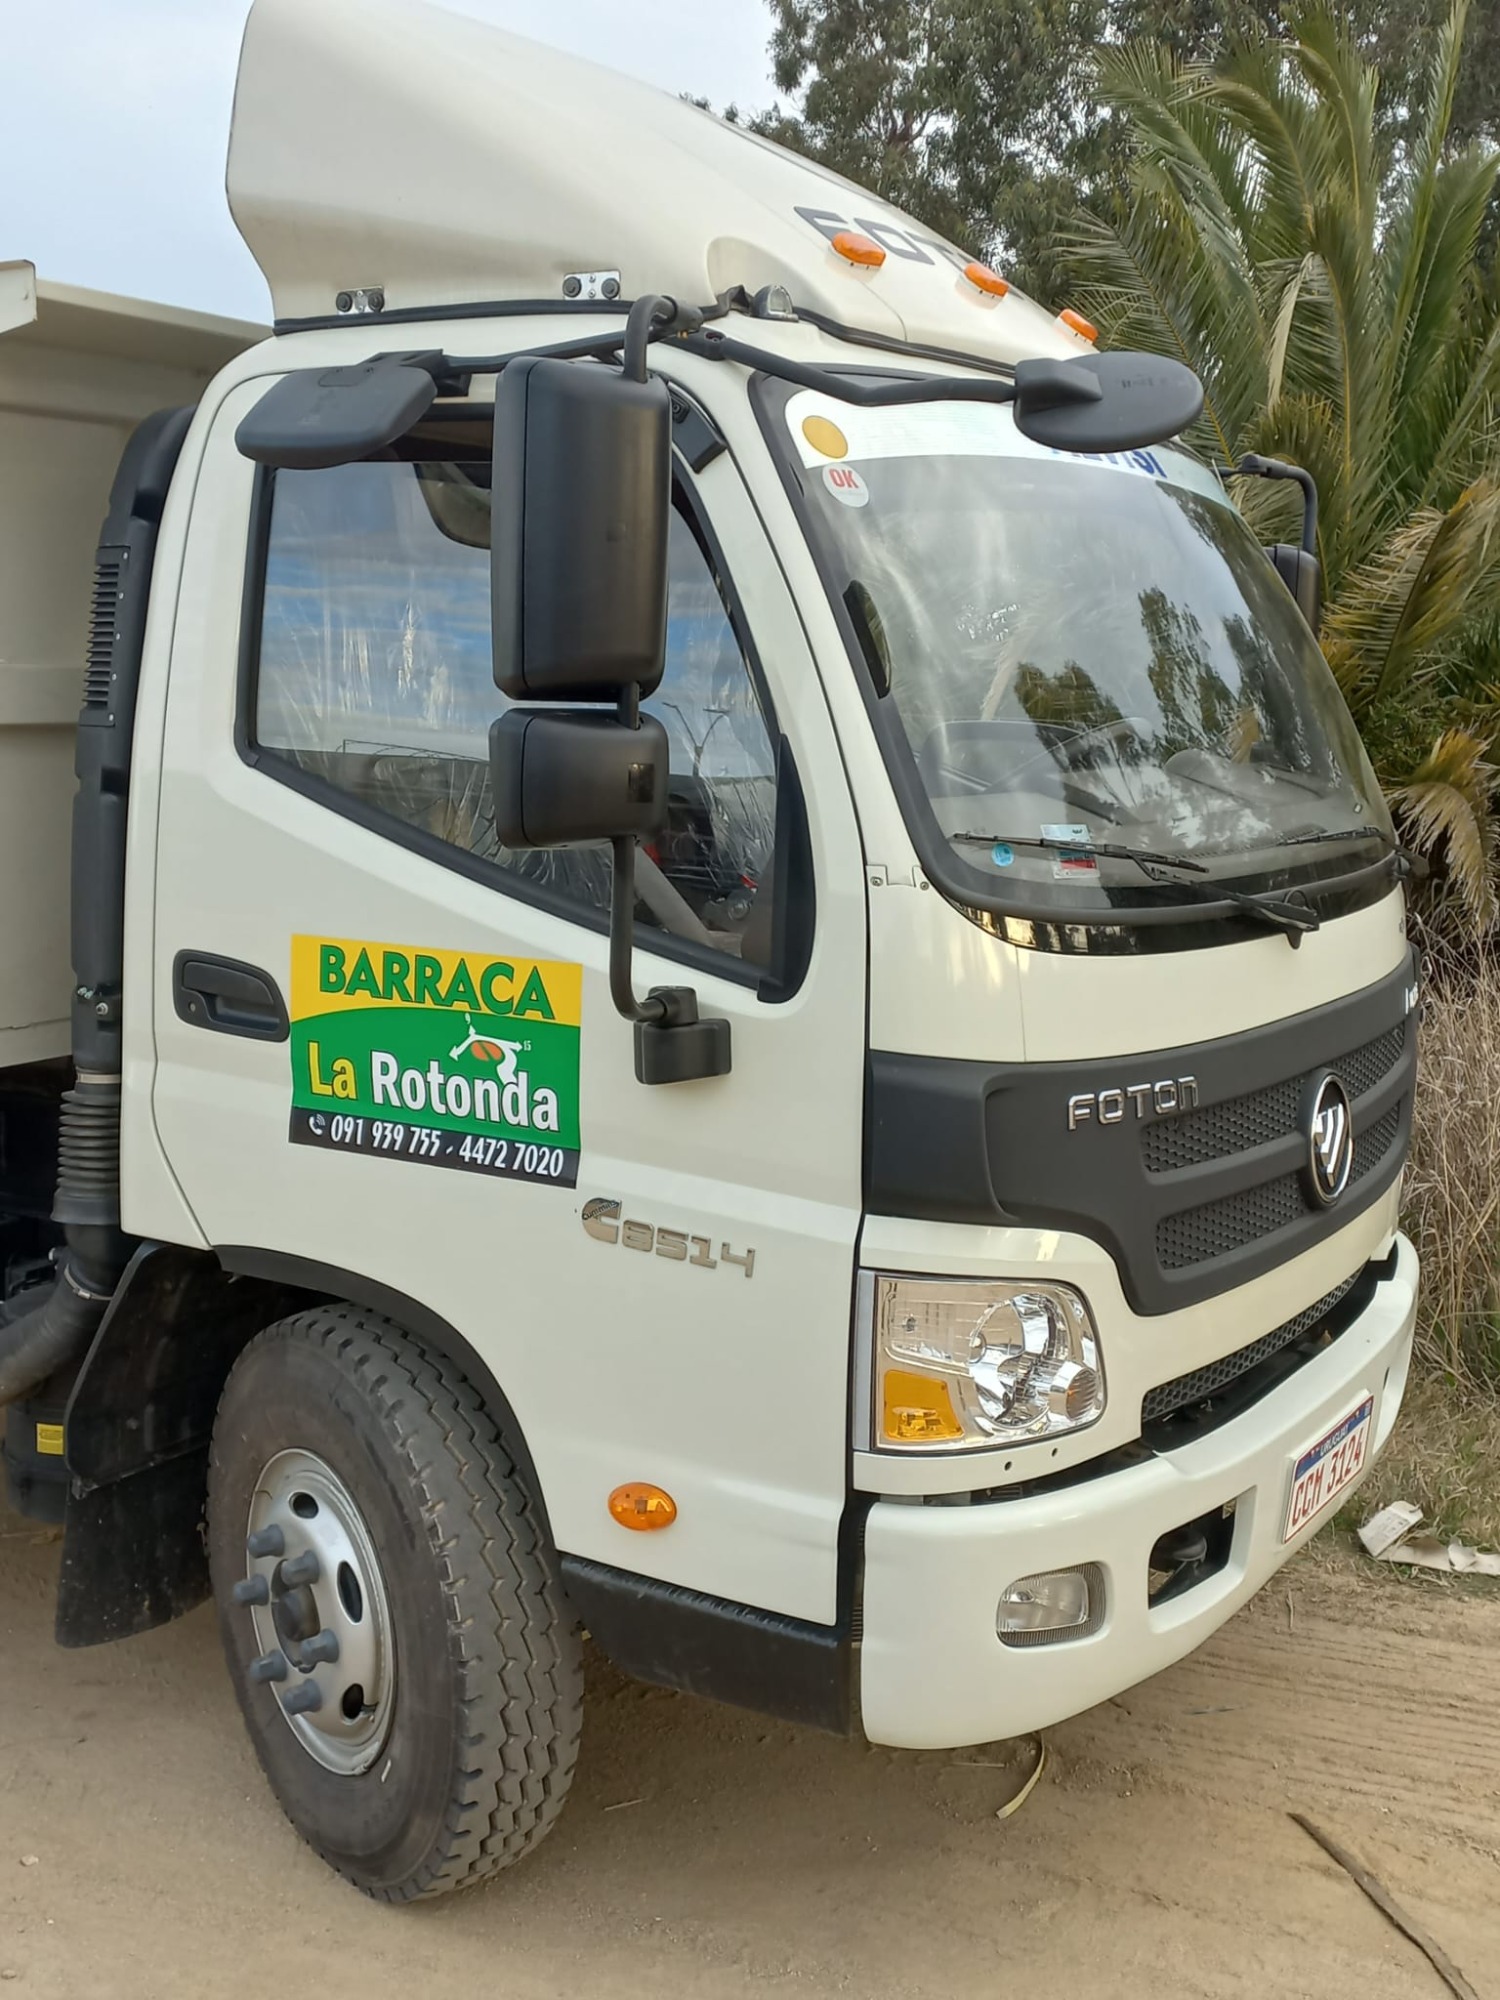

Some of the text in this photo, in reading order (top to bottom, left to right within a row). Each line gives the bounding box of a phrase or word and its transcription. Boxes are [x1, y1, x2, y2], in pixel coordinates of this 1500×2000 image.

[828, 468, 860, 489] OK
[319, 944, 556, 1020] BARRACA
[307, 1041, 560, 1132] La Rotonda
[1068, 1076, 1200, 1131] FOTON
[330, 1115, 364, 1145] 091
[372, 1121, 404, 1151] 939
[409, 1127, 442, 1157] 755
[459, 1135, 507, 1169] 4472
[513, 1143, 564, 1178] 7020
